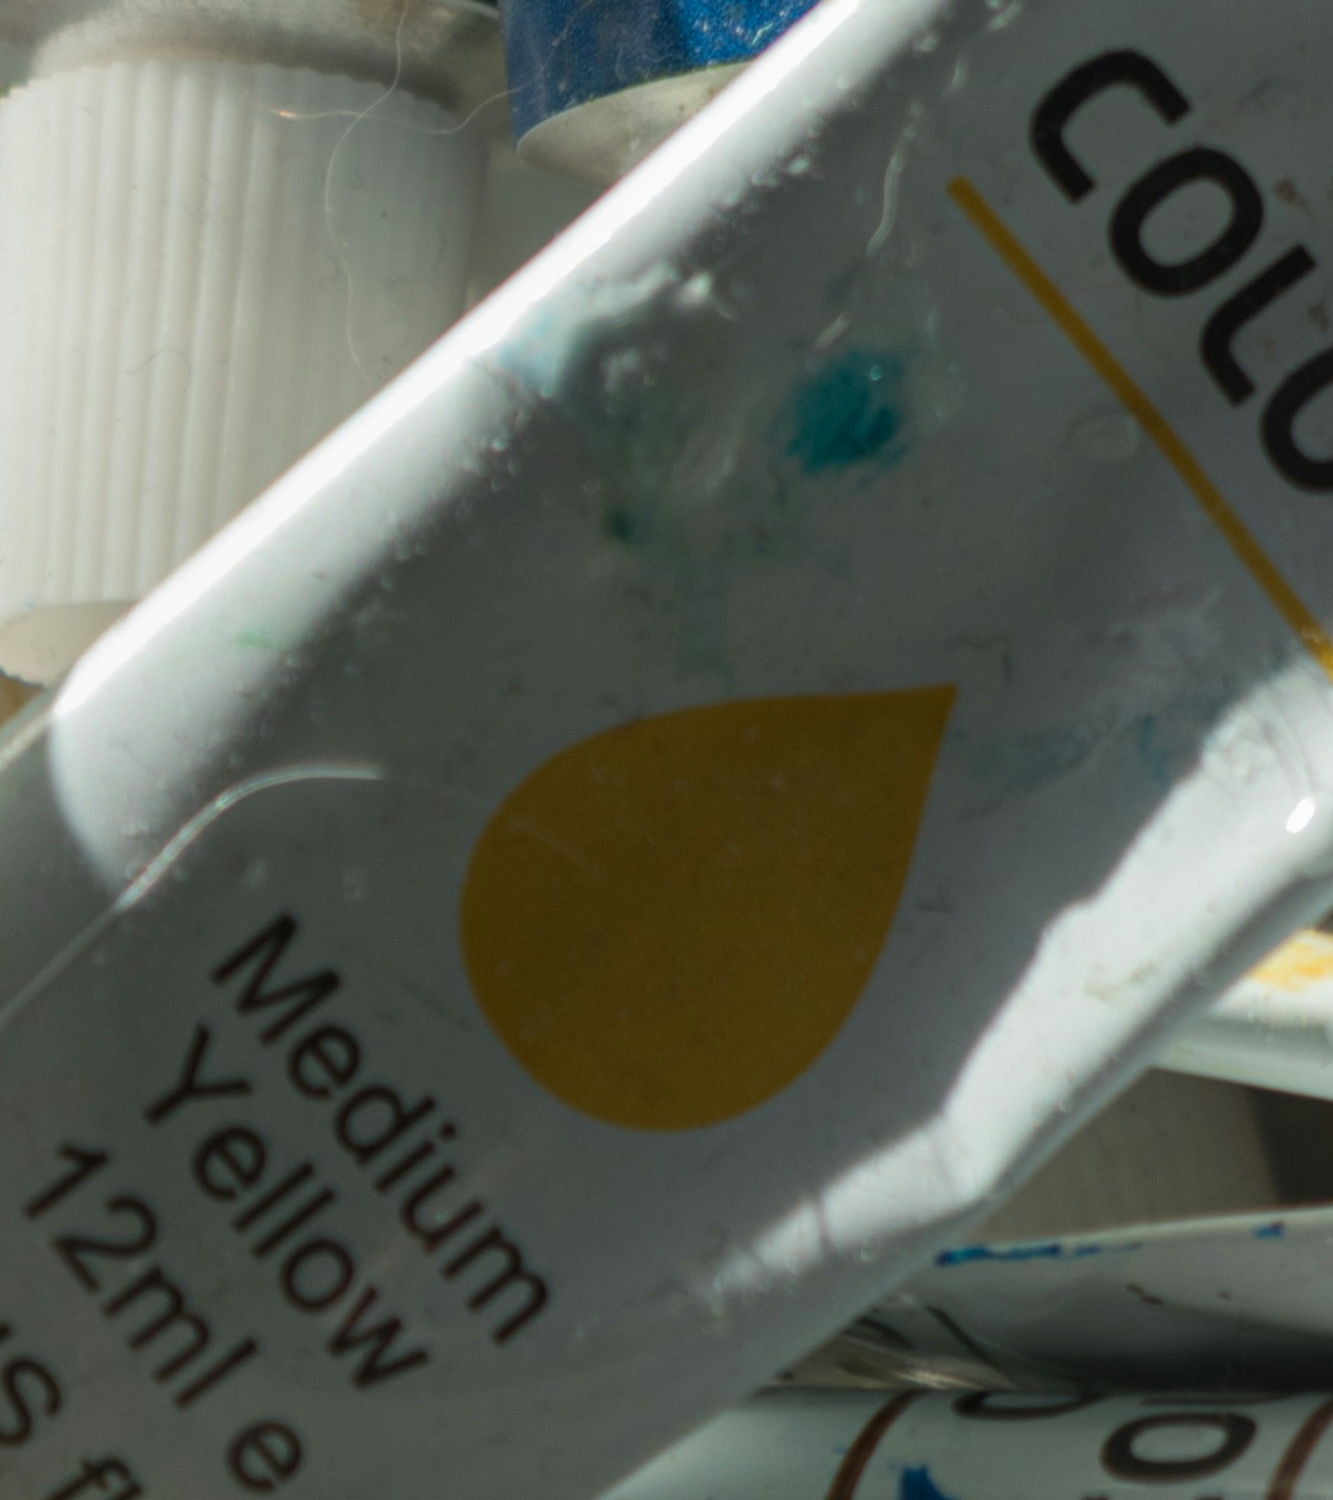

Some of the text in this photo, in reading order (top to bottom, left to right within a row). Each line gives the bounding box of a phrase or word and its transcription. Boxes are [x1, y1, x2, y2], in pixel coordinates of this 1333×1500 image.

[24, 1143, 257, 1410] 12ml
[143, 1023, 428, 1390] Yellow
[210, 912, 549, 1347] Medium
